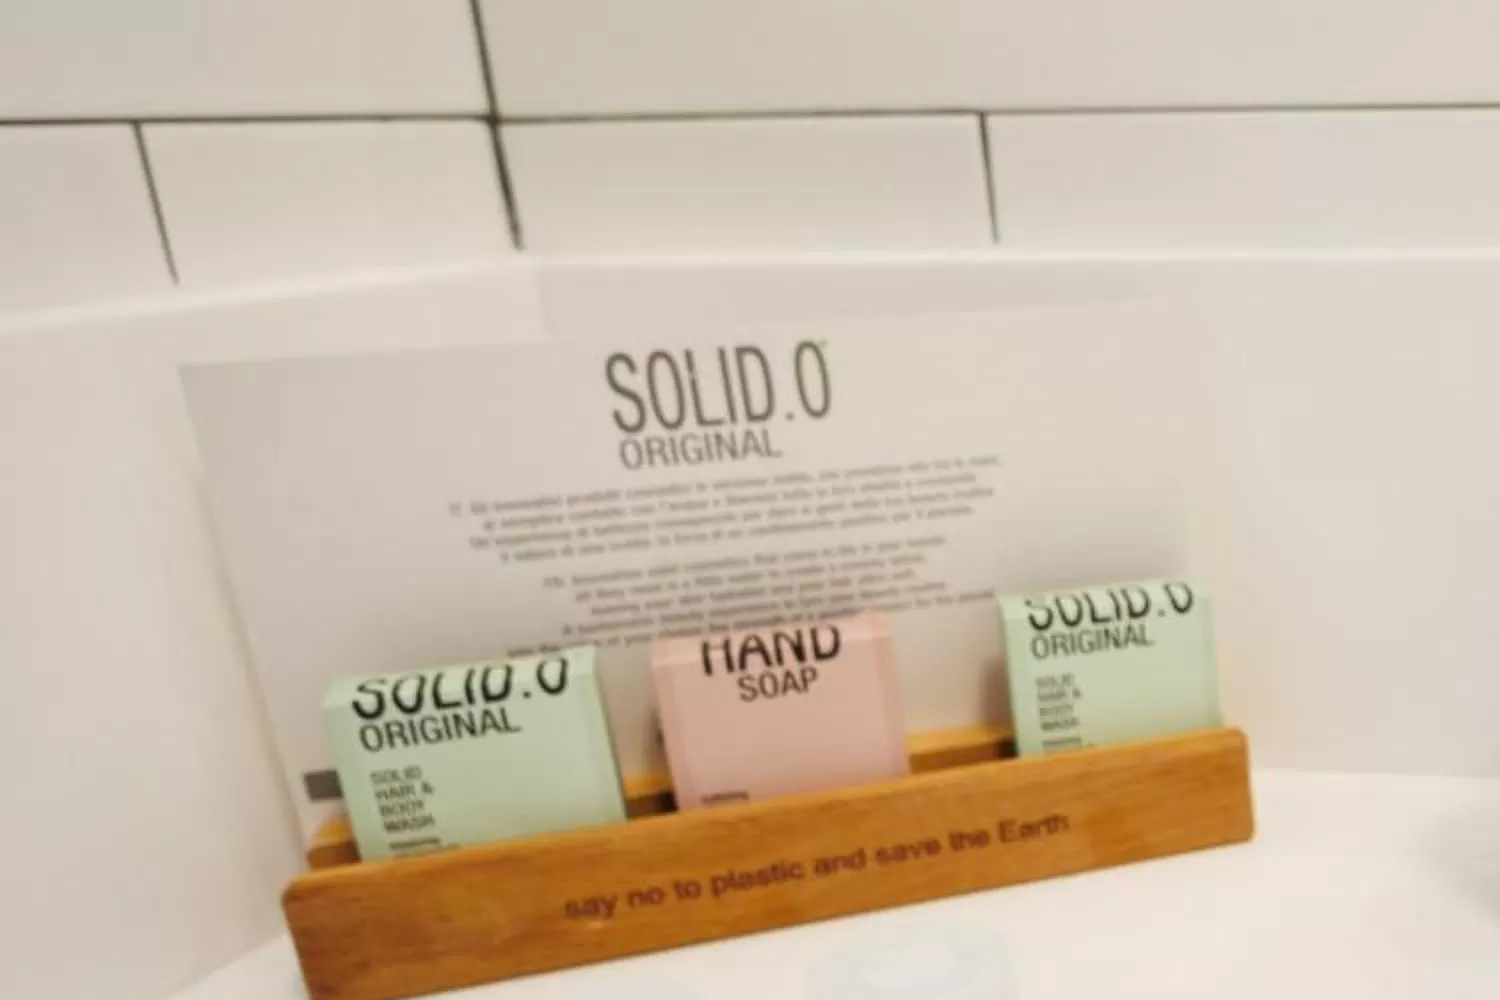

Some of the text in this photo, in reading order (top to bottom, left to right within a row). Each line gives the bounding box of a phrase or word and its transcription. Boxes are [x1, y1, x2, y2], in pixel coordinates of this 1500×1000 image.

[604, 340, 831, 433] SOLID.O
[619, 428, 782, 471] ORIGINAL
[701, 623, 841, 677] HAND
[1030, 623, 1156, 661] ORIGINAL
[737, 667, 819, 702] SOAP
[359, 706, 523, 752] ORIGINAL
[564, 813, 1070, 918] say no to plastic and save the Earth
